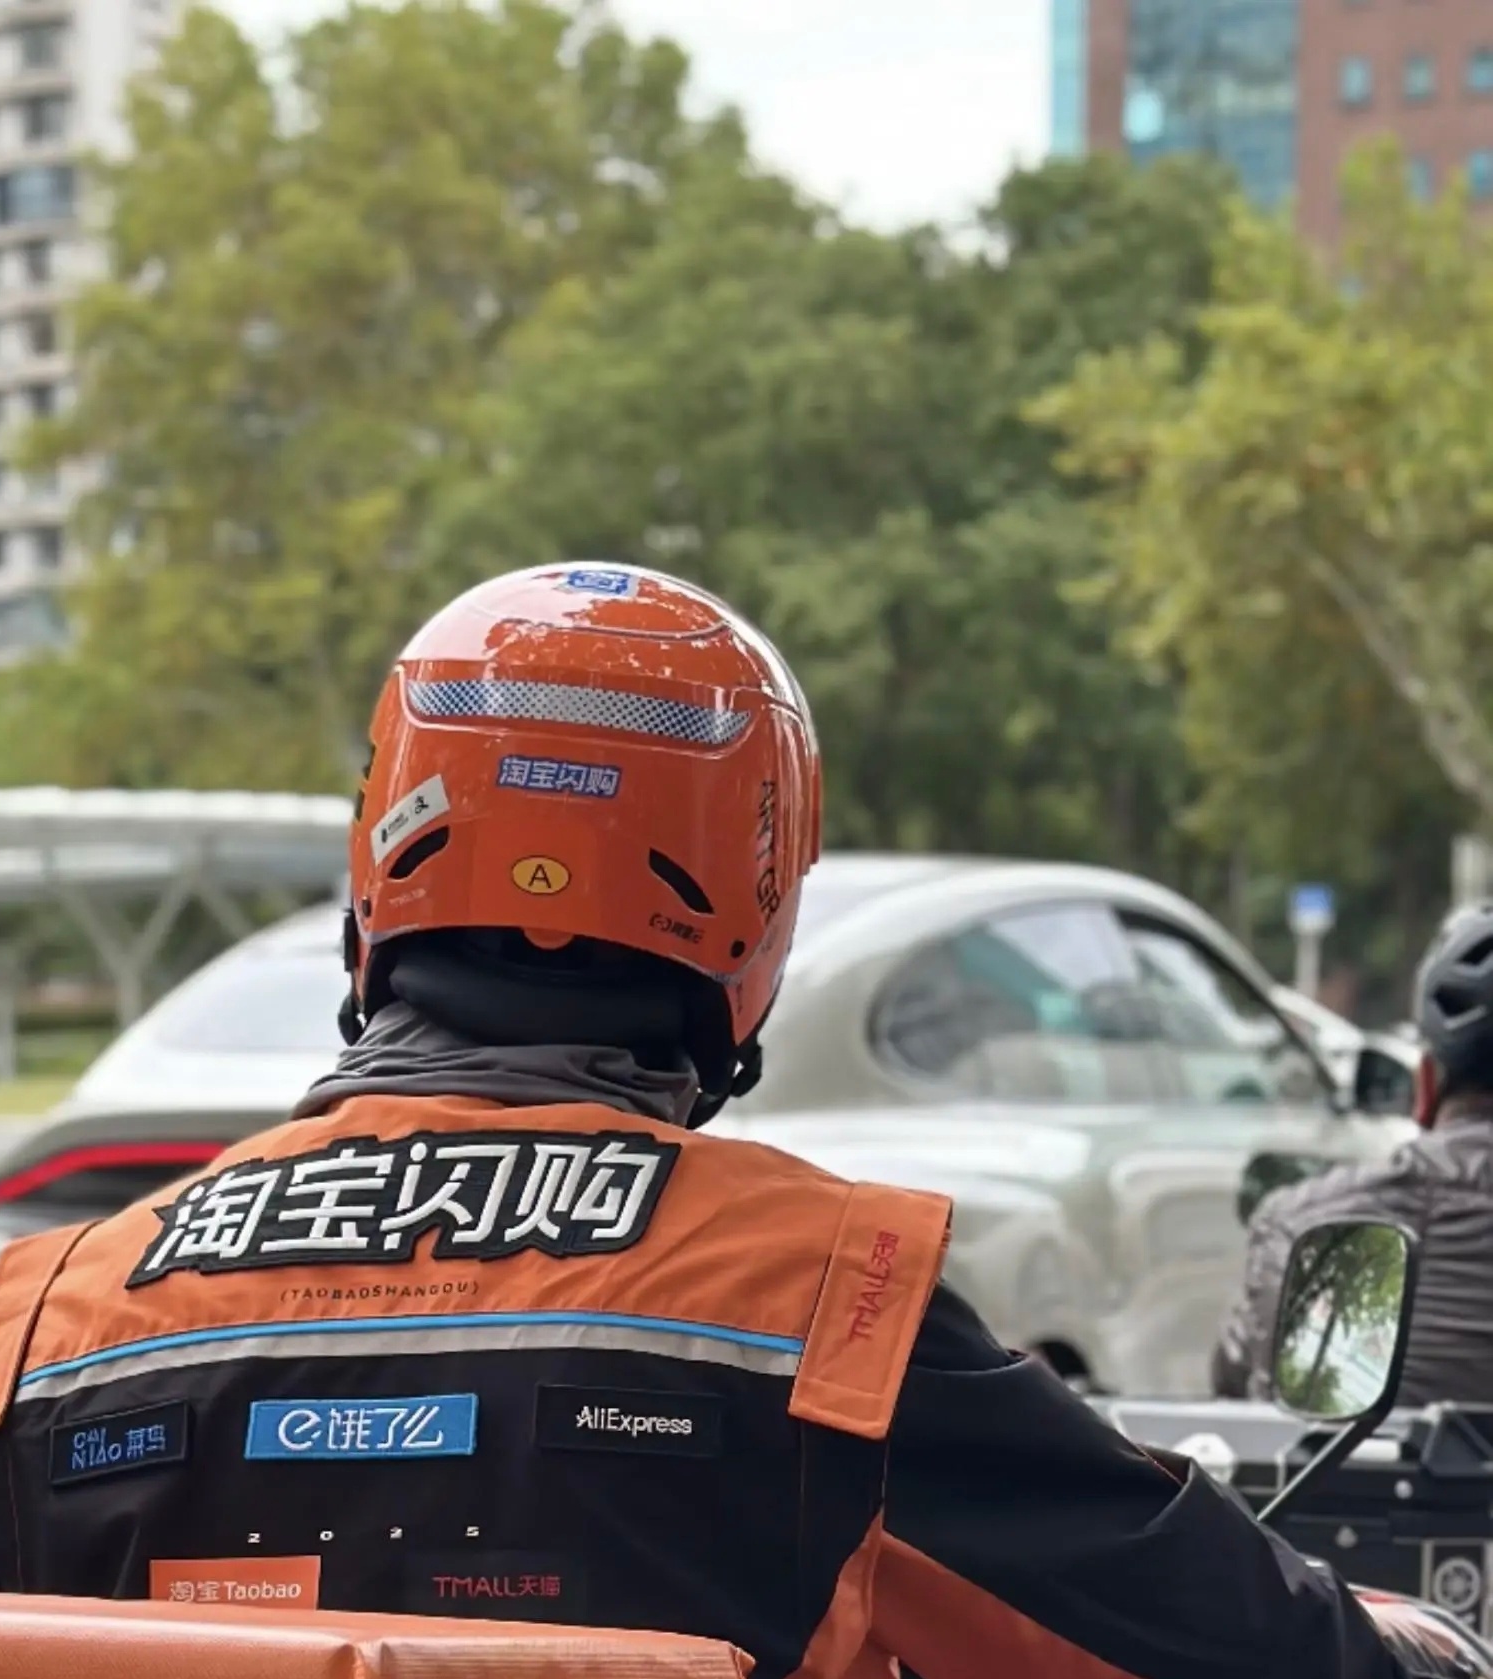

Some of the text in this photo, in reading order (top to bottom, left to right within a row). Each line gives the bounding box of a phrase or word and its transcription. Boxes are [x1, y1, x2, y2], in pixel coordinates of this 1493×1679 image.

[499, 757, 619, 795] 淘宝闪购
[528, 863, 552, 888] A
[145, 1142, 661, 1271] 淘宝闪购
[576, 1405, 692, 1438] AliExpress
